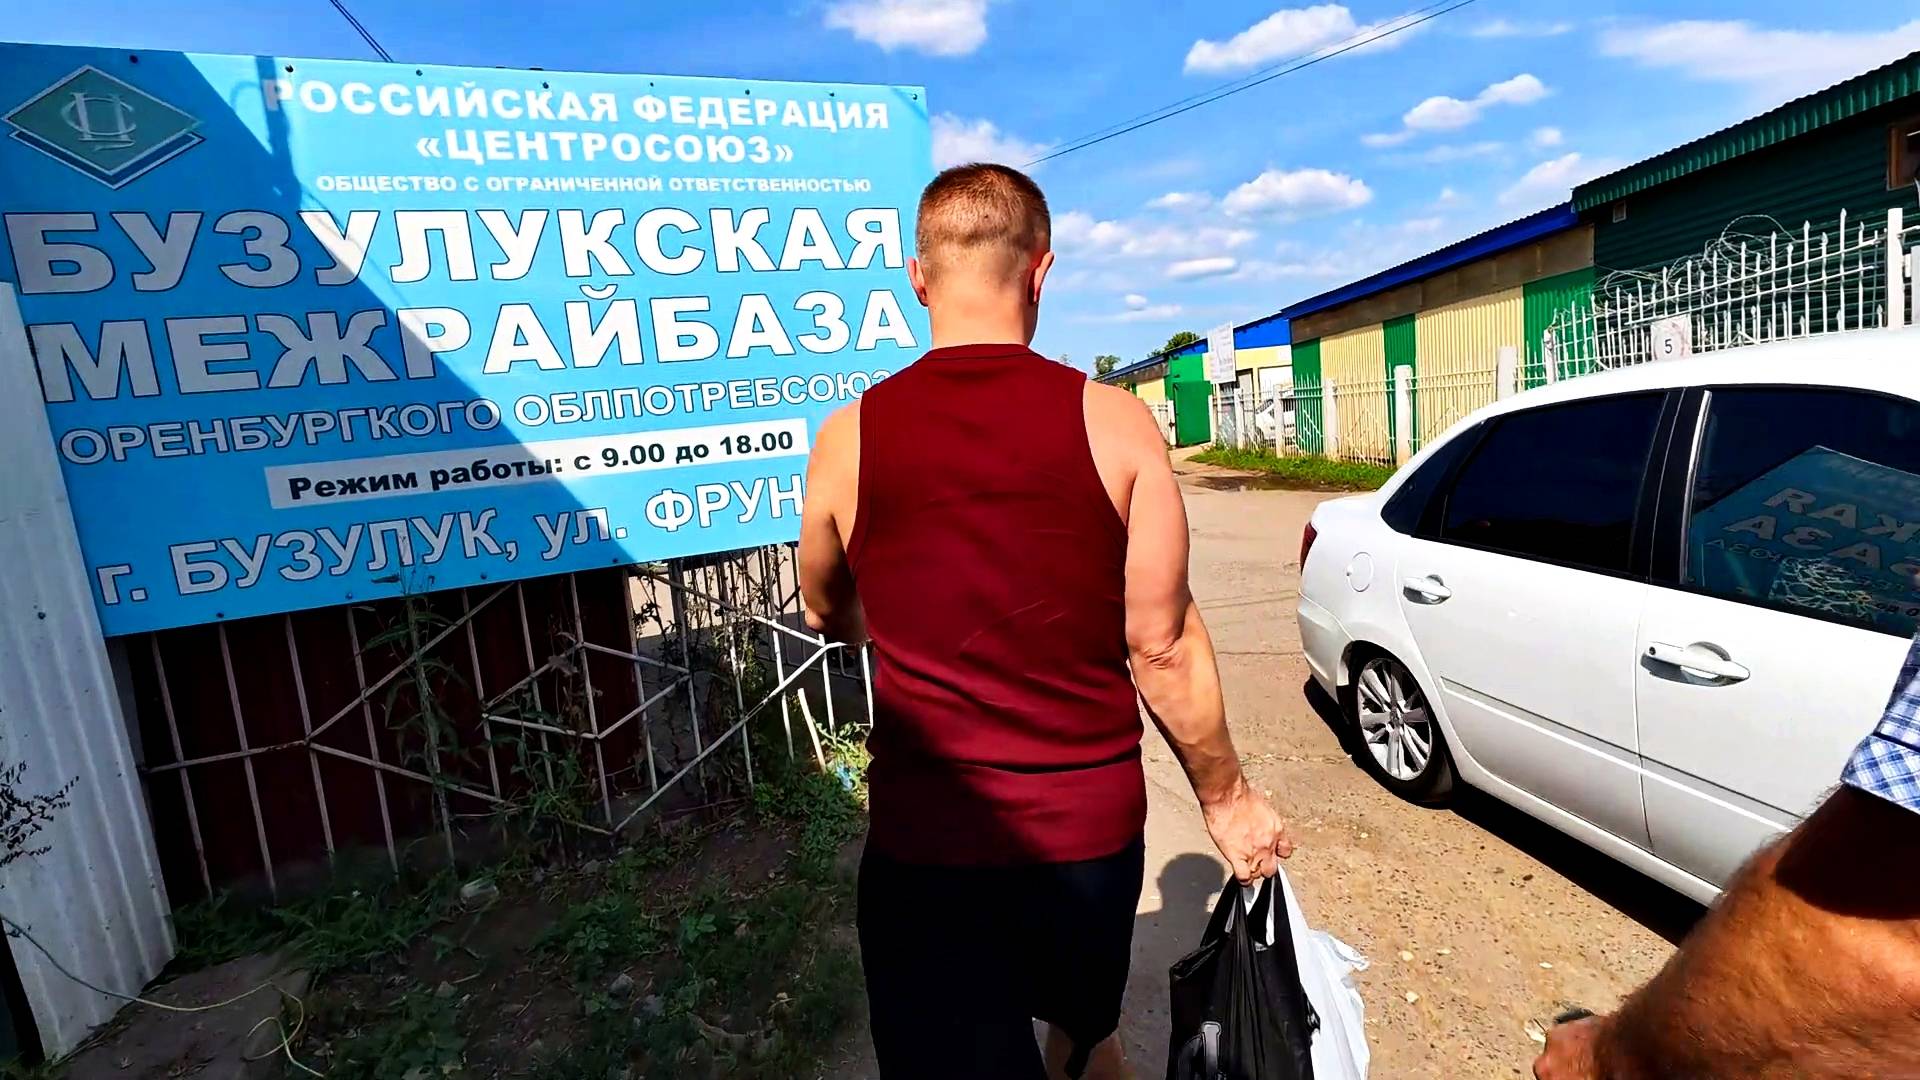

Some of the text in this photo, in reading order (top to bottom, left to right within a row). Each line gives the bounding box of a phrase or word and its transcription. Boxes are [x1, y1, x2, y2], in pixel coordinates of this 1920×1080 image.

[263, 79, 888, 132] РОССИЙСКАЯ ФЕДЕРАЦИЯ
[416, 129, 793, 165] «ЦЕНТРОСОЮЗ»
[316, 173, 872, 194] ОБЩЕСТВО С ОГРАНИЧЕННОЙ ОТВЕТСТВЕННОСТЬЮ
[3, 207, 905, 295] БУЗУЛУКСКАЯ
[28, 283, 919, 402] МЕЖРАЙБАЗА
[1664, 338, 1673, 354] 5
[60, 398, 500, 465] ОРЕНБУРГКОГО
[288, 430, 794, 500] Режим работы: с 9.00 до 18.00
[97, 563, 149, 605] г.
[169, 509, 518, 596] БУЗУЛУК,
[533, 508, 628, 560] ул.
